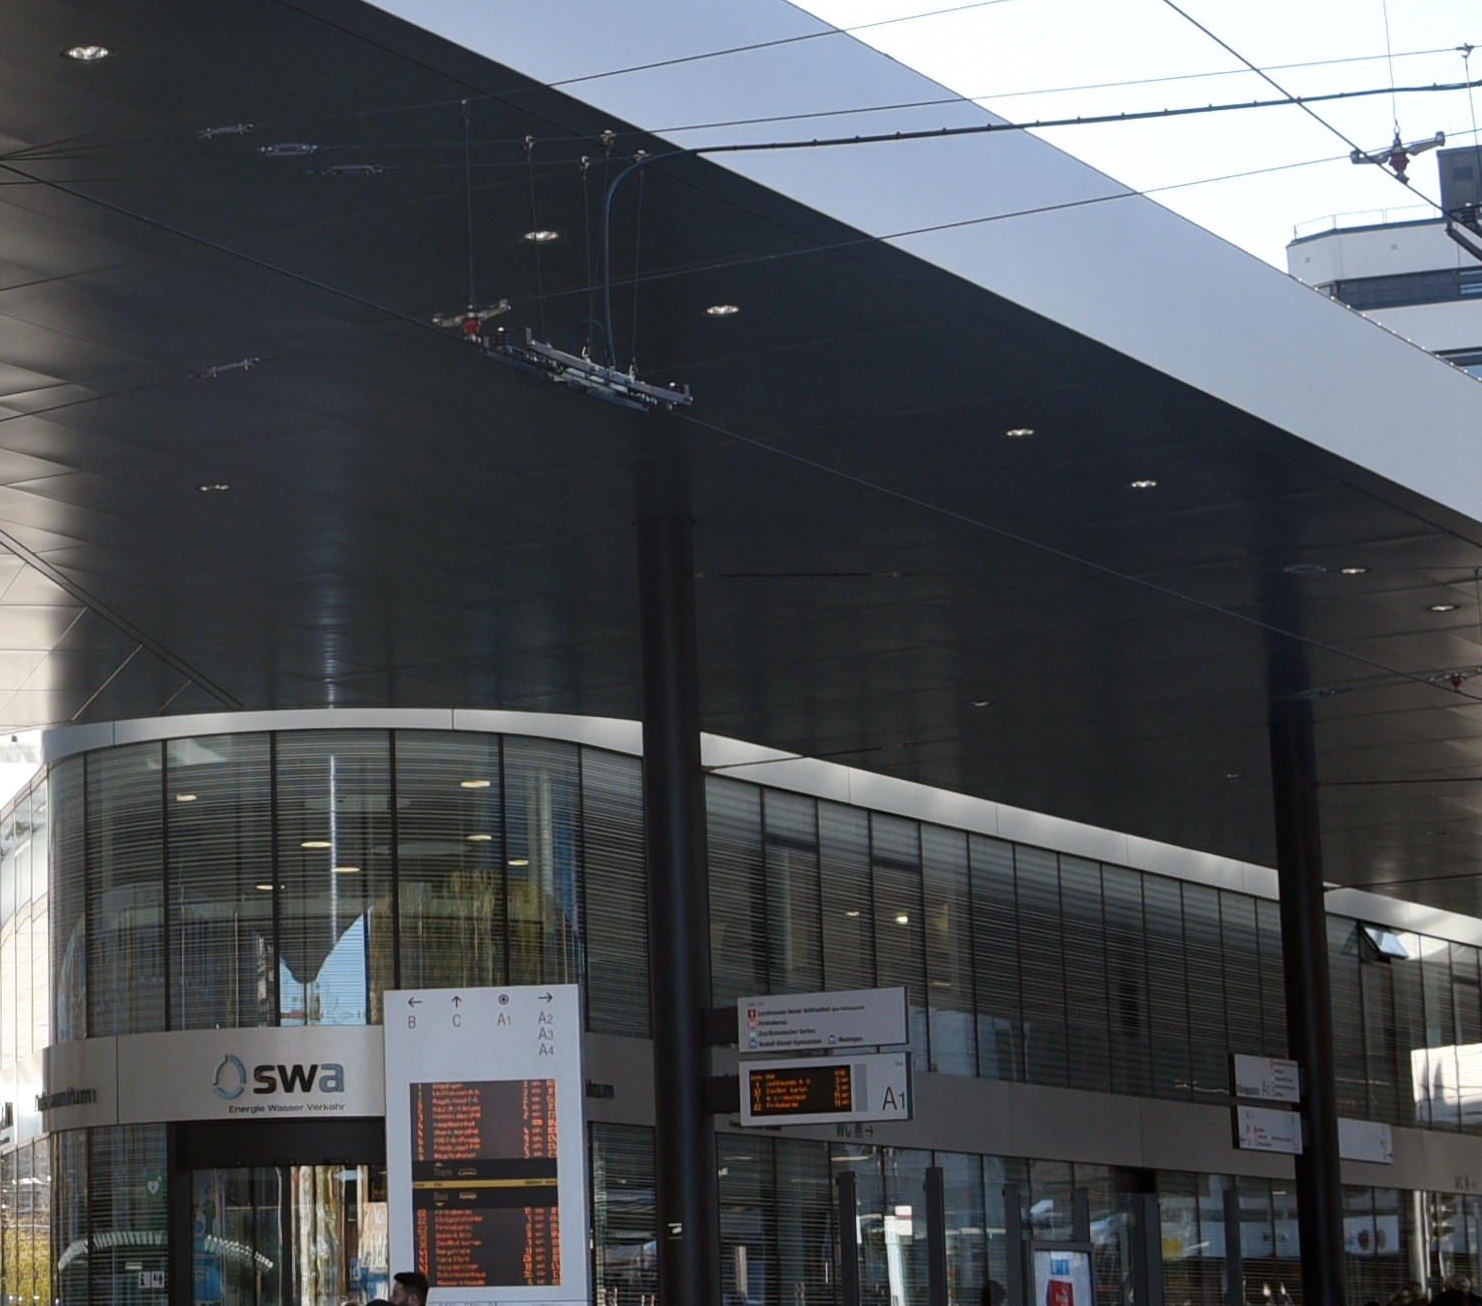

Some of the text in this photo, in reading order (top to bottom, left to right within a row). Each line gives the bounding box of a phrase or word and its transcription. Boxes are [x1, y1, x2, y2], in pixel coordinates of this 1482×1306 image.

[408, 1012, 554, 1028] B C A1 A2
[538, 1028, 554, 1040] A3
[538, 1044, 554, 1056] A4
[253, 1063, 345, 1094] swa
[882, 1086, 905, 1110] A1
[229, 1103, 346, 1114] Energie Wasser Verkehr
